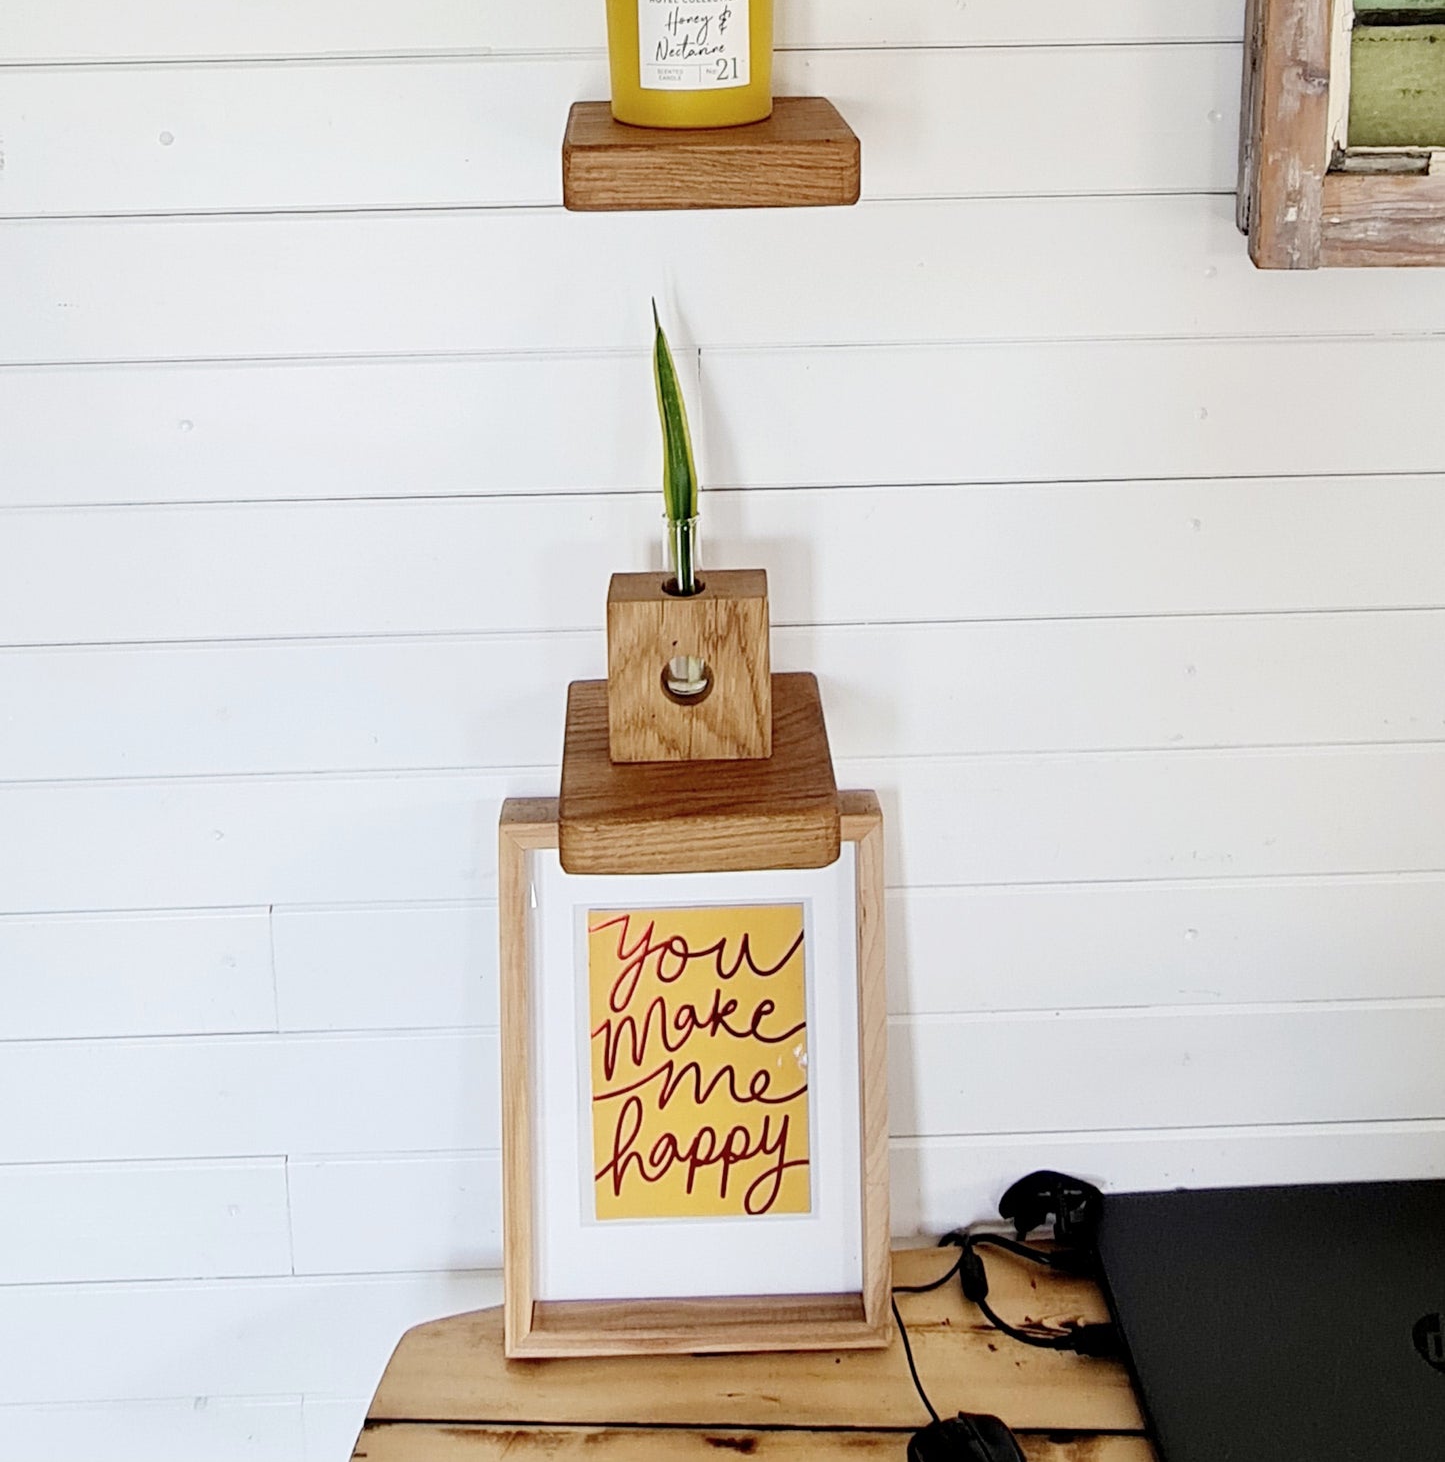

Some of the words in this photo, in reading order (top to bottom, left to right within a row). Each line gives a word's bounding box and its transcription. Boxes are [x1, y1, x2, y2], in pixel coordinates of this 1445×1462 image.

[664, 6, 713, 45] Honey
[655, 34, 727, 62] Nectarine
[716, 56, 739, 81] 21
[592, 1059, 808, 1110] me
[595, 1094, 810, 1216] happy
